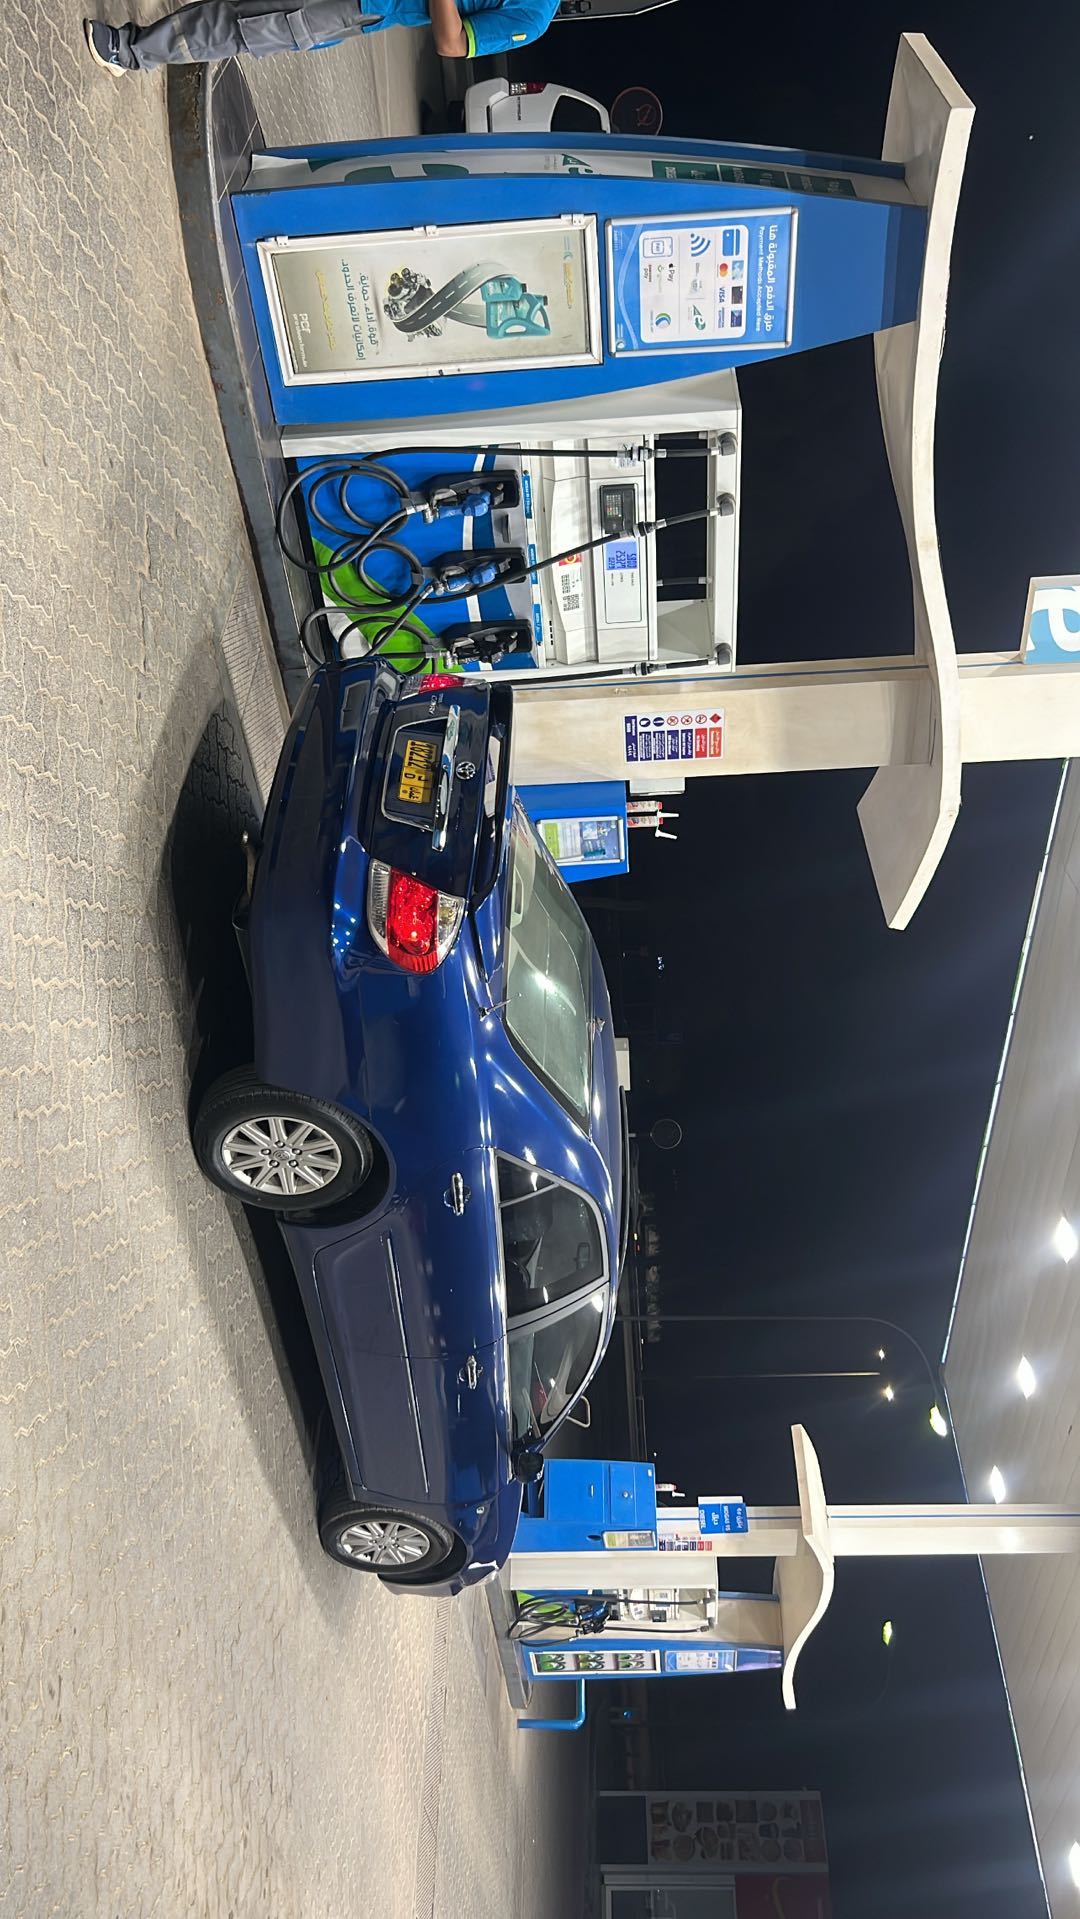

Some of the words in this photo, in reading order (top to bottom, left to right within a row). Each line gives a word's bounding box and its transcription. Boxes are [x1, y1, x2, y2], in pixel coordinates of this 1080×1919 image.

[769, 224, 778, 240] هنا
[766, 243, 777, 283] المقبولة
[765, 285, 774, 310] الدفع
[764, 313, 774, 332] طرق
[407, 741, 434, 769] 18212
